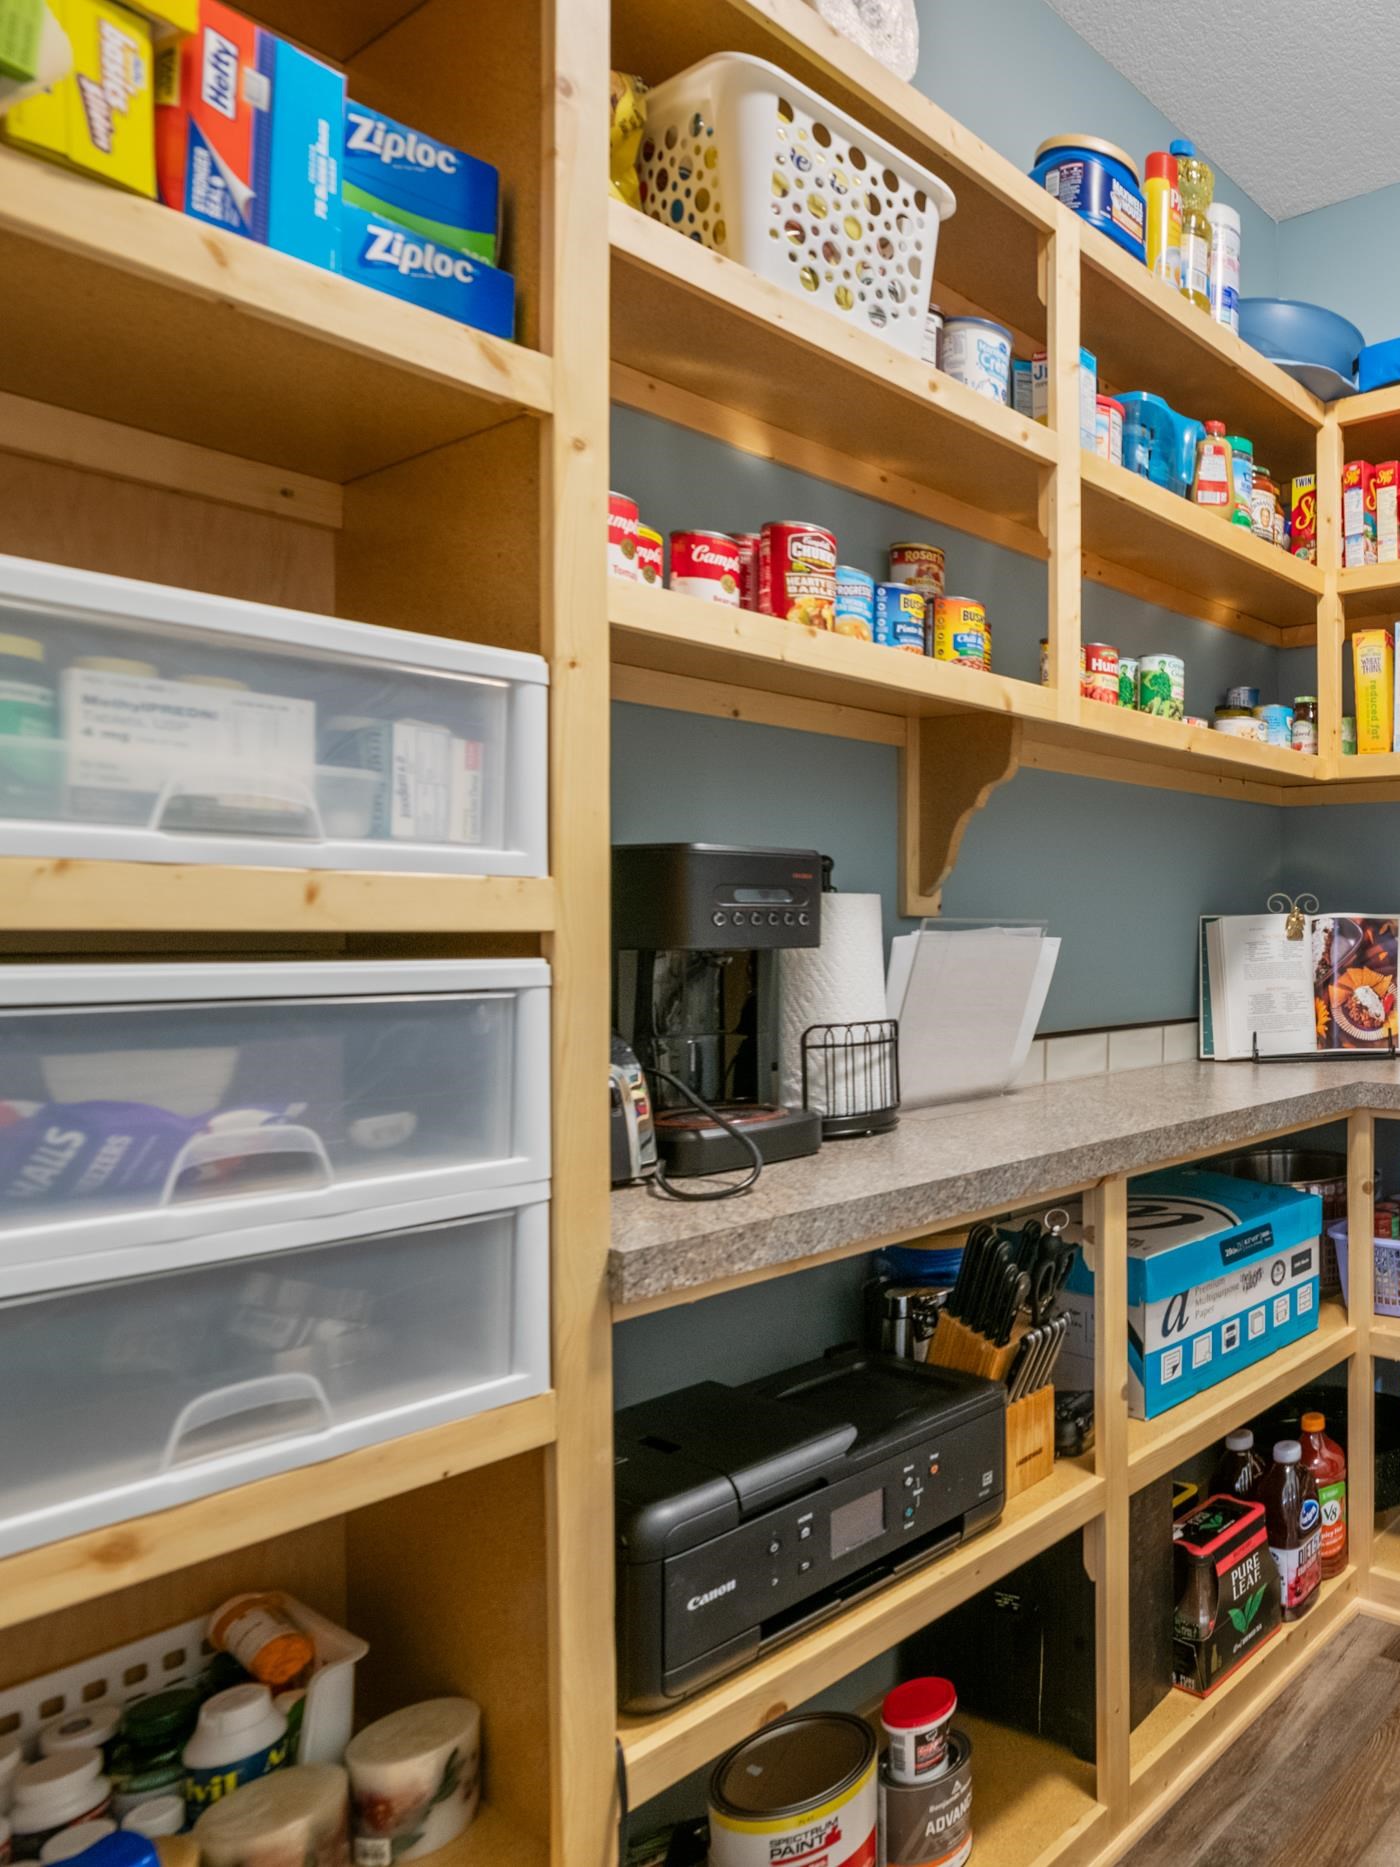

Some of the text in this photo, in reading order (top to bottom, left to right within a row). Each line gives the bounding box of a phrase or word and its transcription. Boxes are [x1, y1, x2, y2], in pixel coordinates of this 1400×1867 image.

[209, 36, 238, 111] Hefty
[346, 112, 457, 174] Ziploc
[364, 223, 475, 284] Ziploc
[1370, 680, 1379, 740] reduced fat
[1323, 1503, 1338, 1522] V8
[1231, 1552, 1260, 1586] PURE
[1233, 1566, 1261, 1600] LEAF
[687, 1579, 736, 1611] Canon
[769, 1816, 840, 1848] SPECTRUM
[769, 1831, 826, 1861] PAINT
